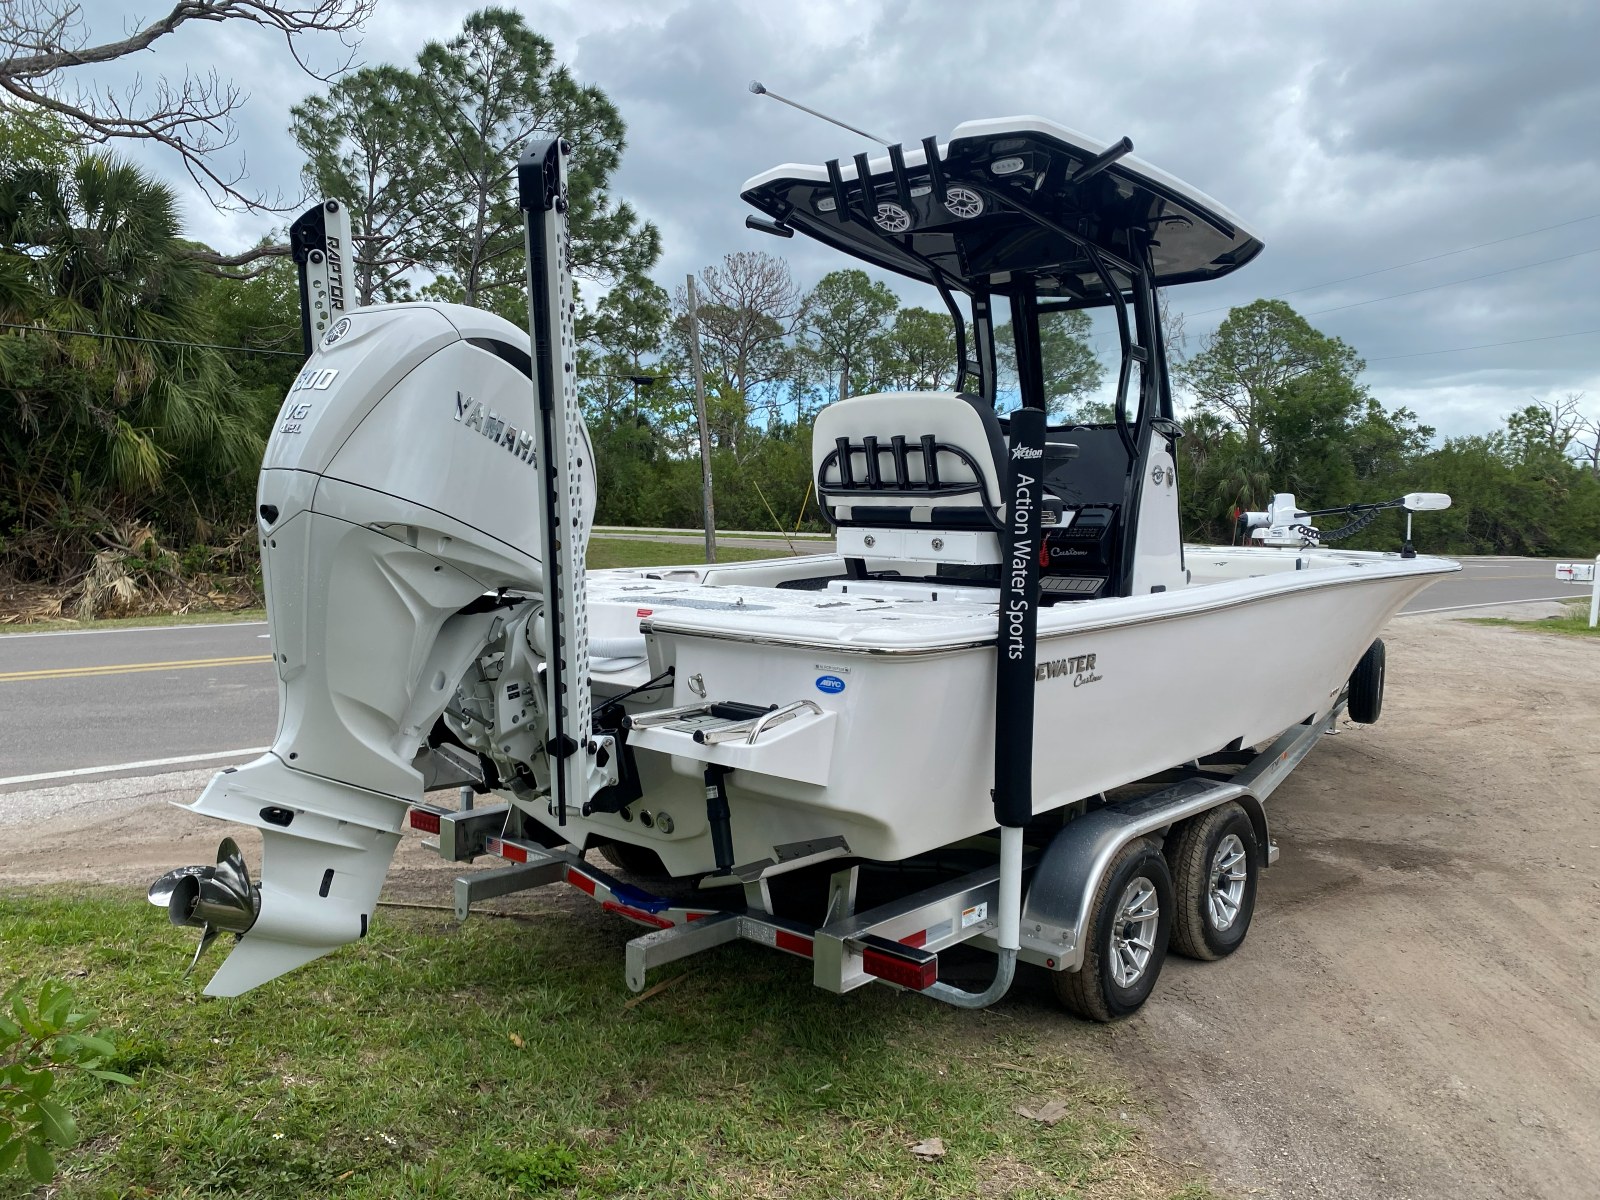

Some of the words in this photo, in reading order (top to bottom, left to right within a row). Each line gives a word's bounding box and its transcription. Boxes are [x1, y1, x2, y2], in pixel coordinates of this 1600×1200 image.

[327, 235, 344, 311] RAPTOR
[285, 403, 312, 420] V6
[1014, 473, 1035, 535] Action
[1011, 539, 1032, 596] Water
[1050, 547, 1088, 556] Custom
[1005, 600, 1029, 660] Sports
[1035, 653, 1097, 681] EWATER
